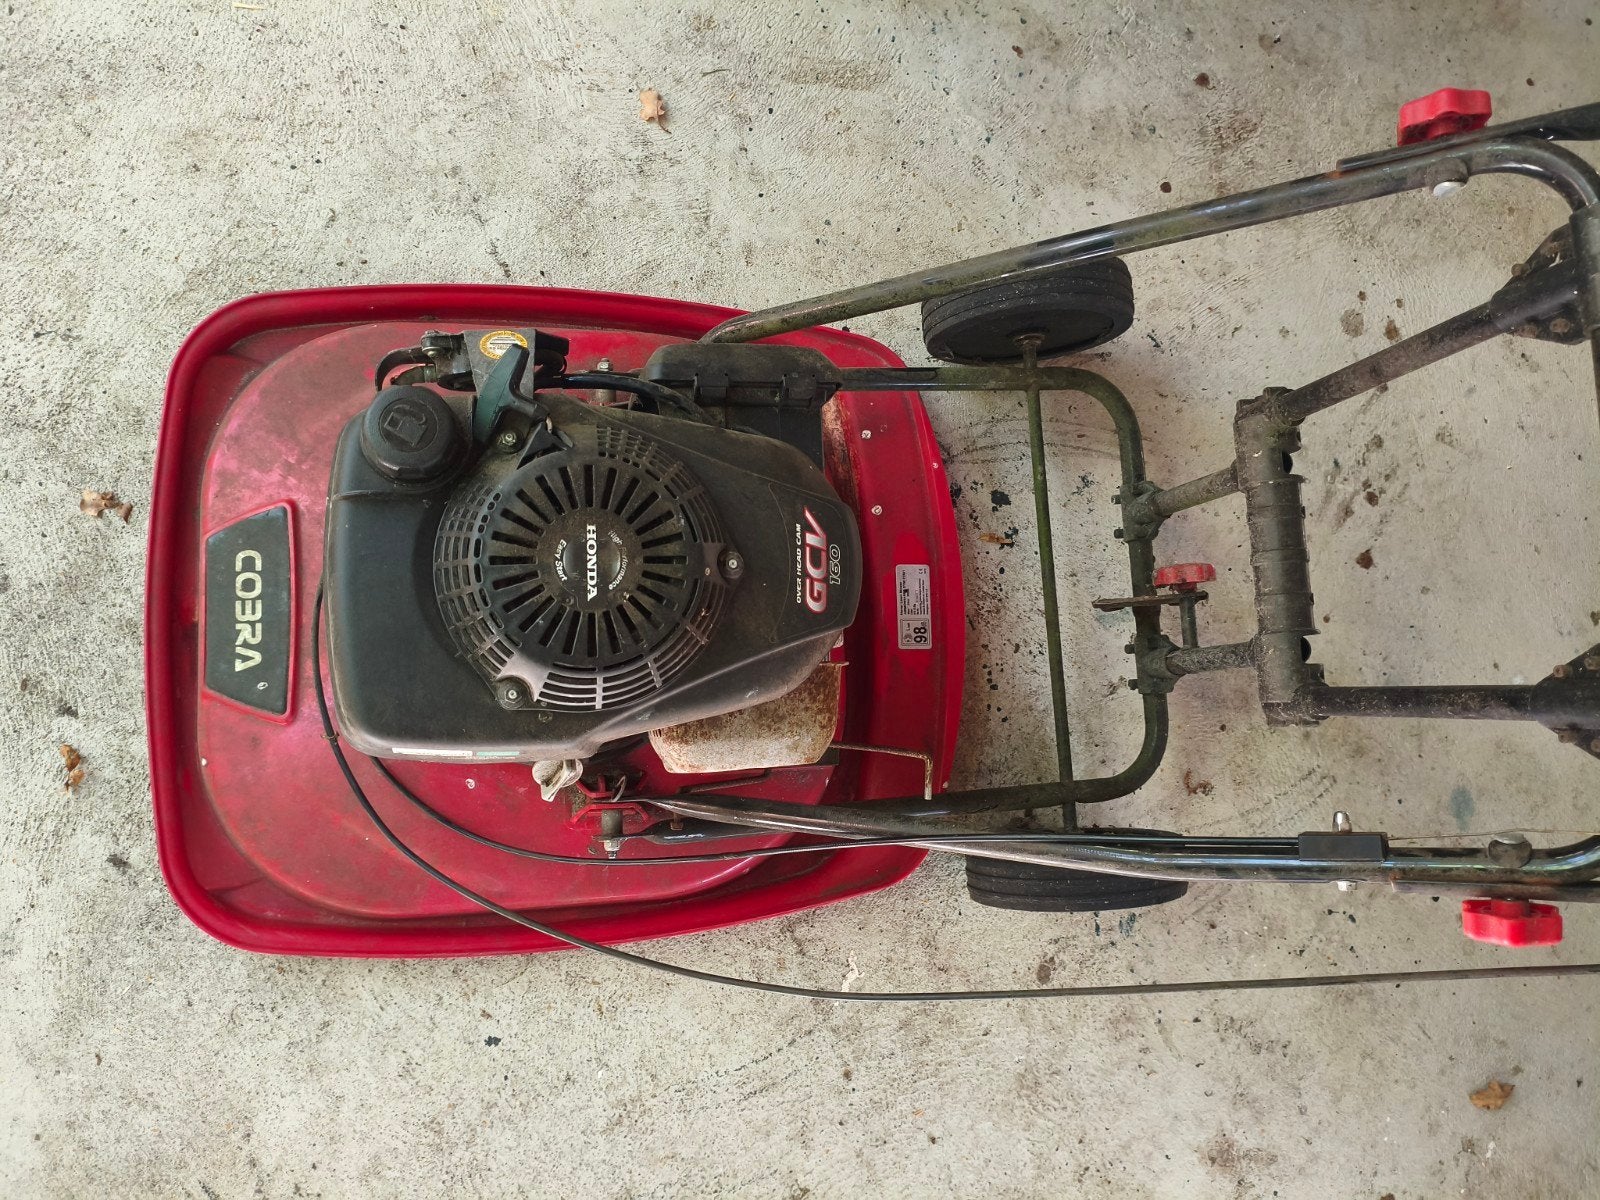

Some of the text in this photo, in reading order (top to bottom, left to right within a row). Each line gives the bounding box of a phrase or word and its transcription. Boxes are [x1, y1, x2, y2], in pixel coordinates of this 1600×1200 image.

[554, 539, 568, 582] Easy Start
[586, 524, 598, 601] HONDA
[608, 530, 628, 590] High Performance
[803, 505, 828, 613] GCV
[829, 544, 841, 585] 160
[234, 549, 262, 672] COBRA
[913, 626, 928, 643] 98
